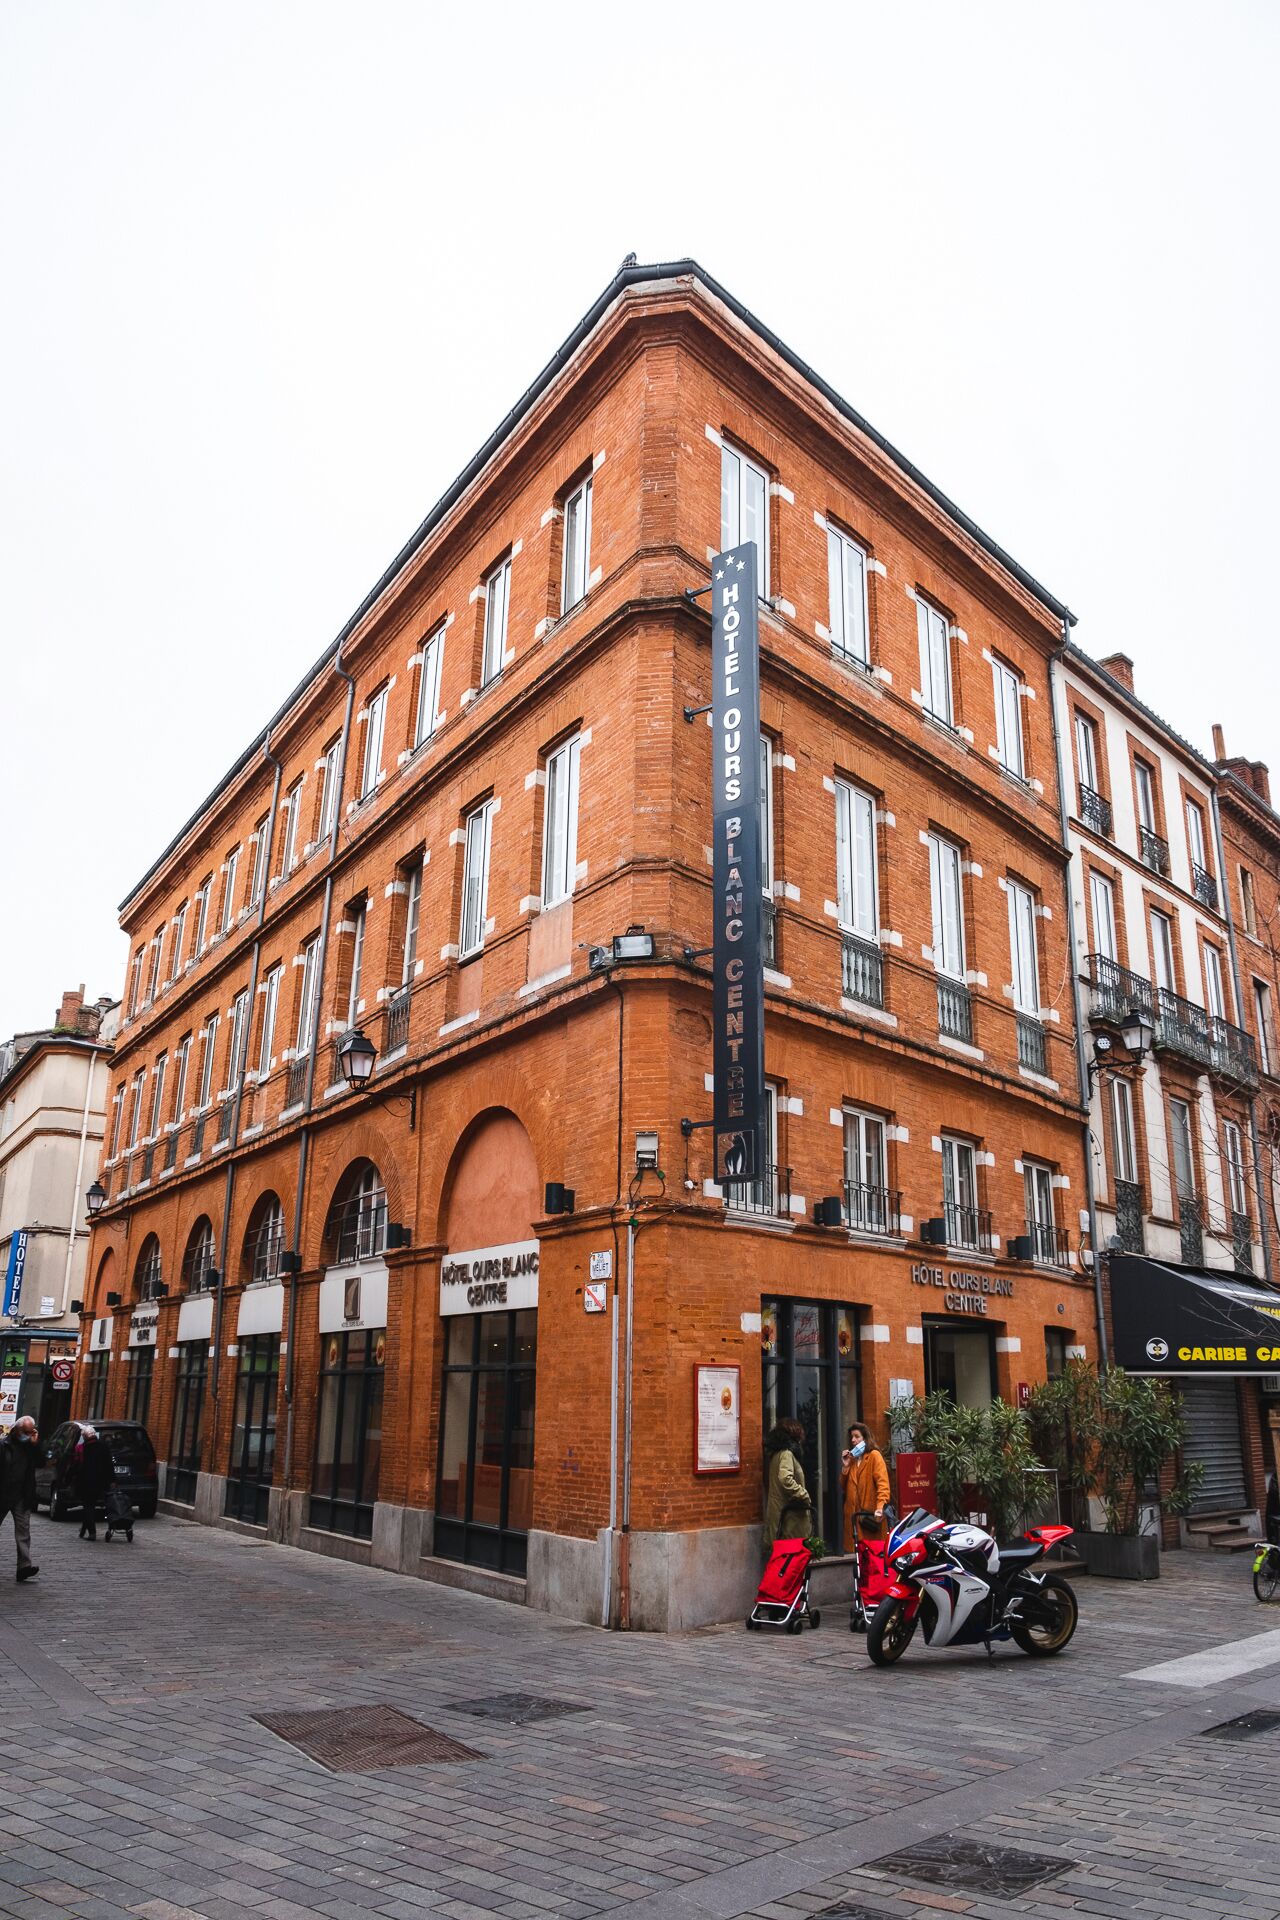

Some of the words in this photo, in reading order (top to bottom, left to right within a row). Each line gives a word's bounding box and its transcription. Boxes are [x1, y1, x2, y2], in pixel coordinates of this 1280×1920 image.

[722, 583, 741, 697] HÔTEL
[723, 707, 742, 802] OURS
[725, 816, 744, 943] BLANC
[725, 957, 745, 1119] CENTRE
[11, 1232, 28, 1304] HOTEL
[442, 1260, 473, 1287] HÔTEL
[473, 1257, 502, 1282] OURS
[502, 1251, 540, 1278] BLANC
[467, 1281, 508, 1307] CENTRE
[911, 1261, 949, 1288] HÔTEL
[950, 1270, 980, 1292] OURS
[981, 1275, 1014, 1297] BLANC
[944, 1292, 988, 1315] CENTRE
[1177, 1347, 1248, 1361] CARIBE
